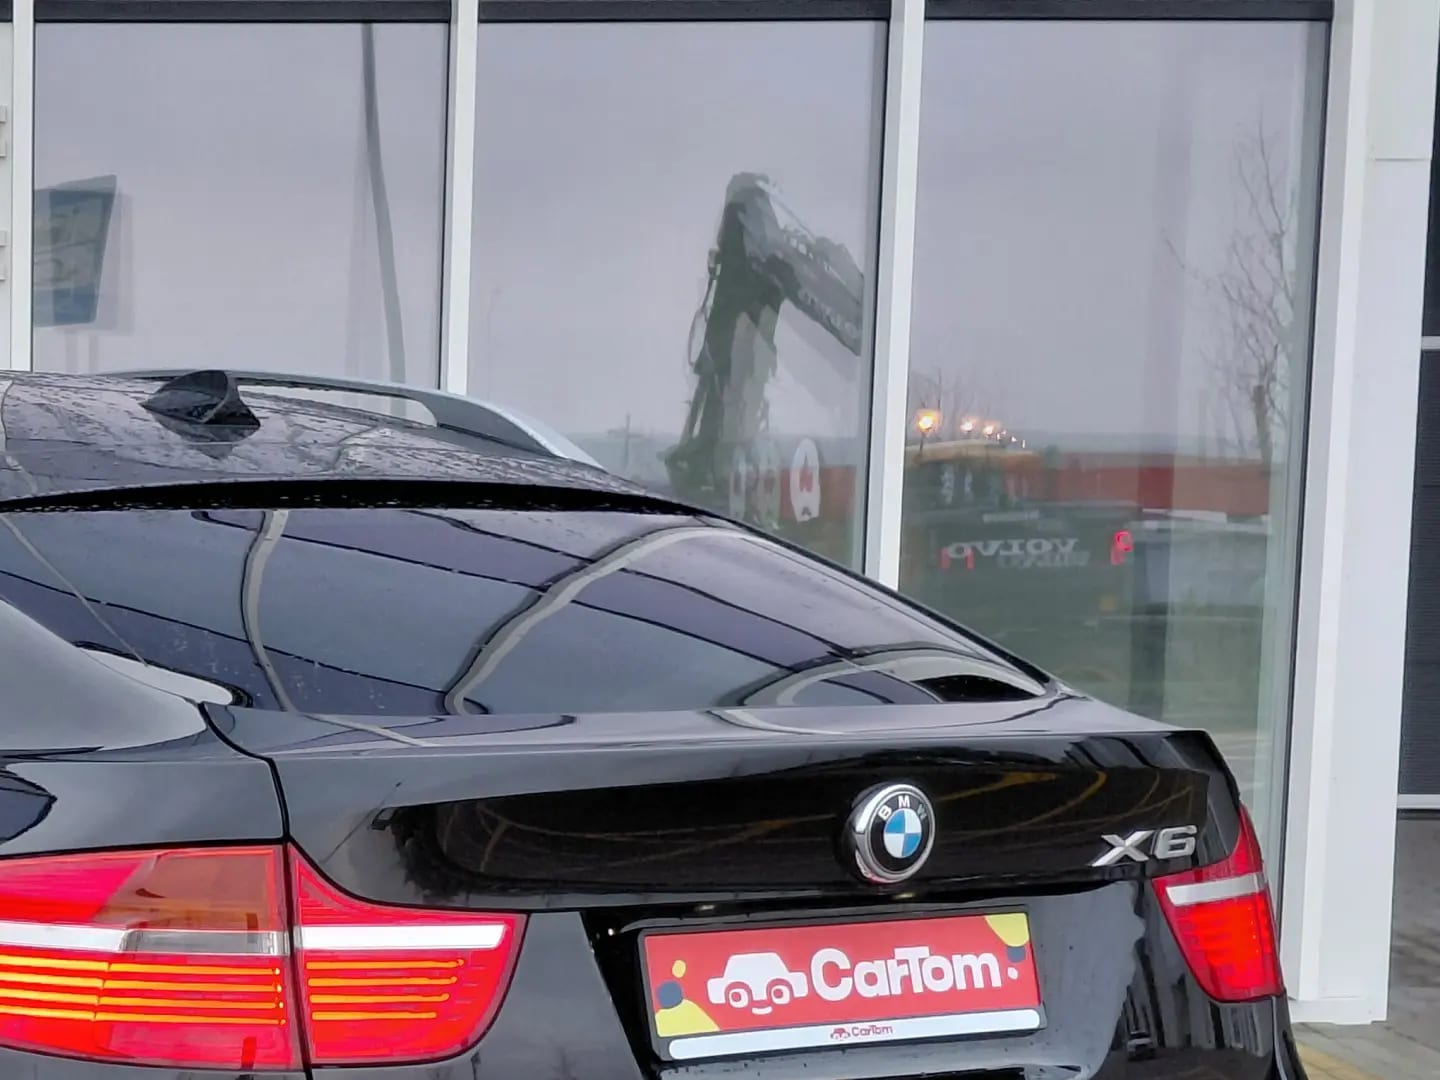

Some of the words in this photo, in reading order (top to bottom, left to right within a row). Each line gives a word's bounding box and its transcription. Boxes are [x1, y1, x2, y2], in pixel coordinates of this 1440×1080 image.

[878, 795, 927, 821] BMW
[1087, 825, 1198, 868] X6
[810, 946, 1002, 1002] CarTom
[851, 1023, 894, 1038] CarTom
